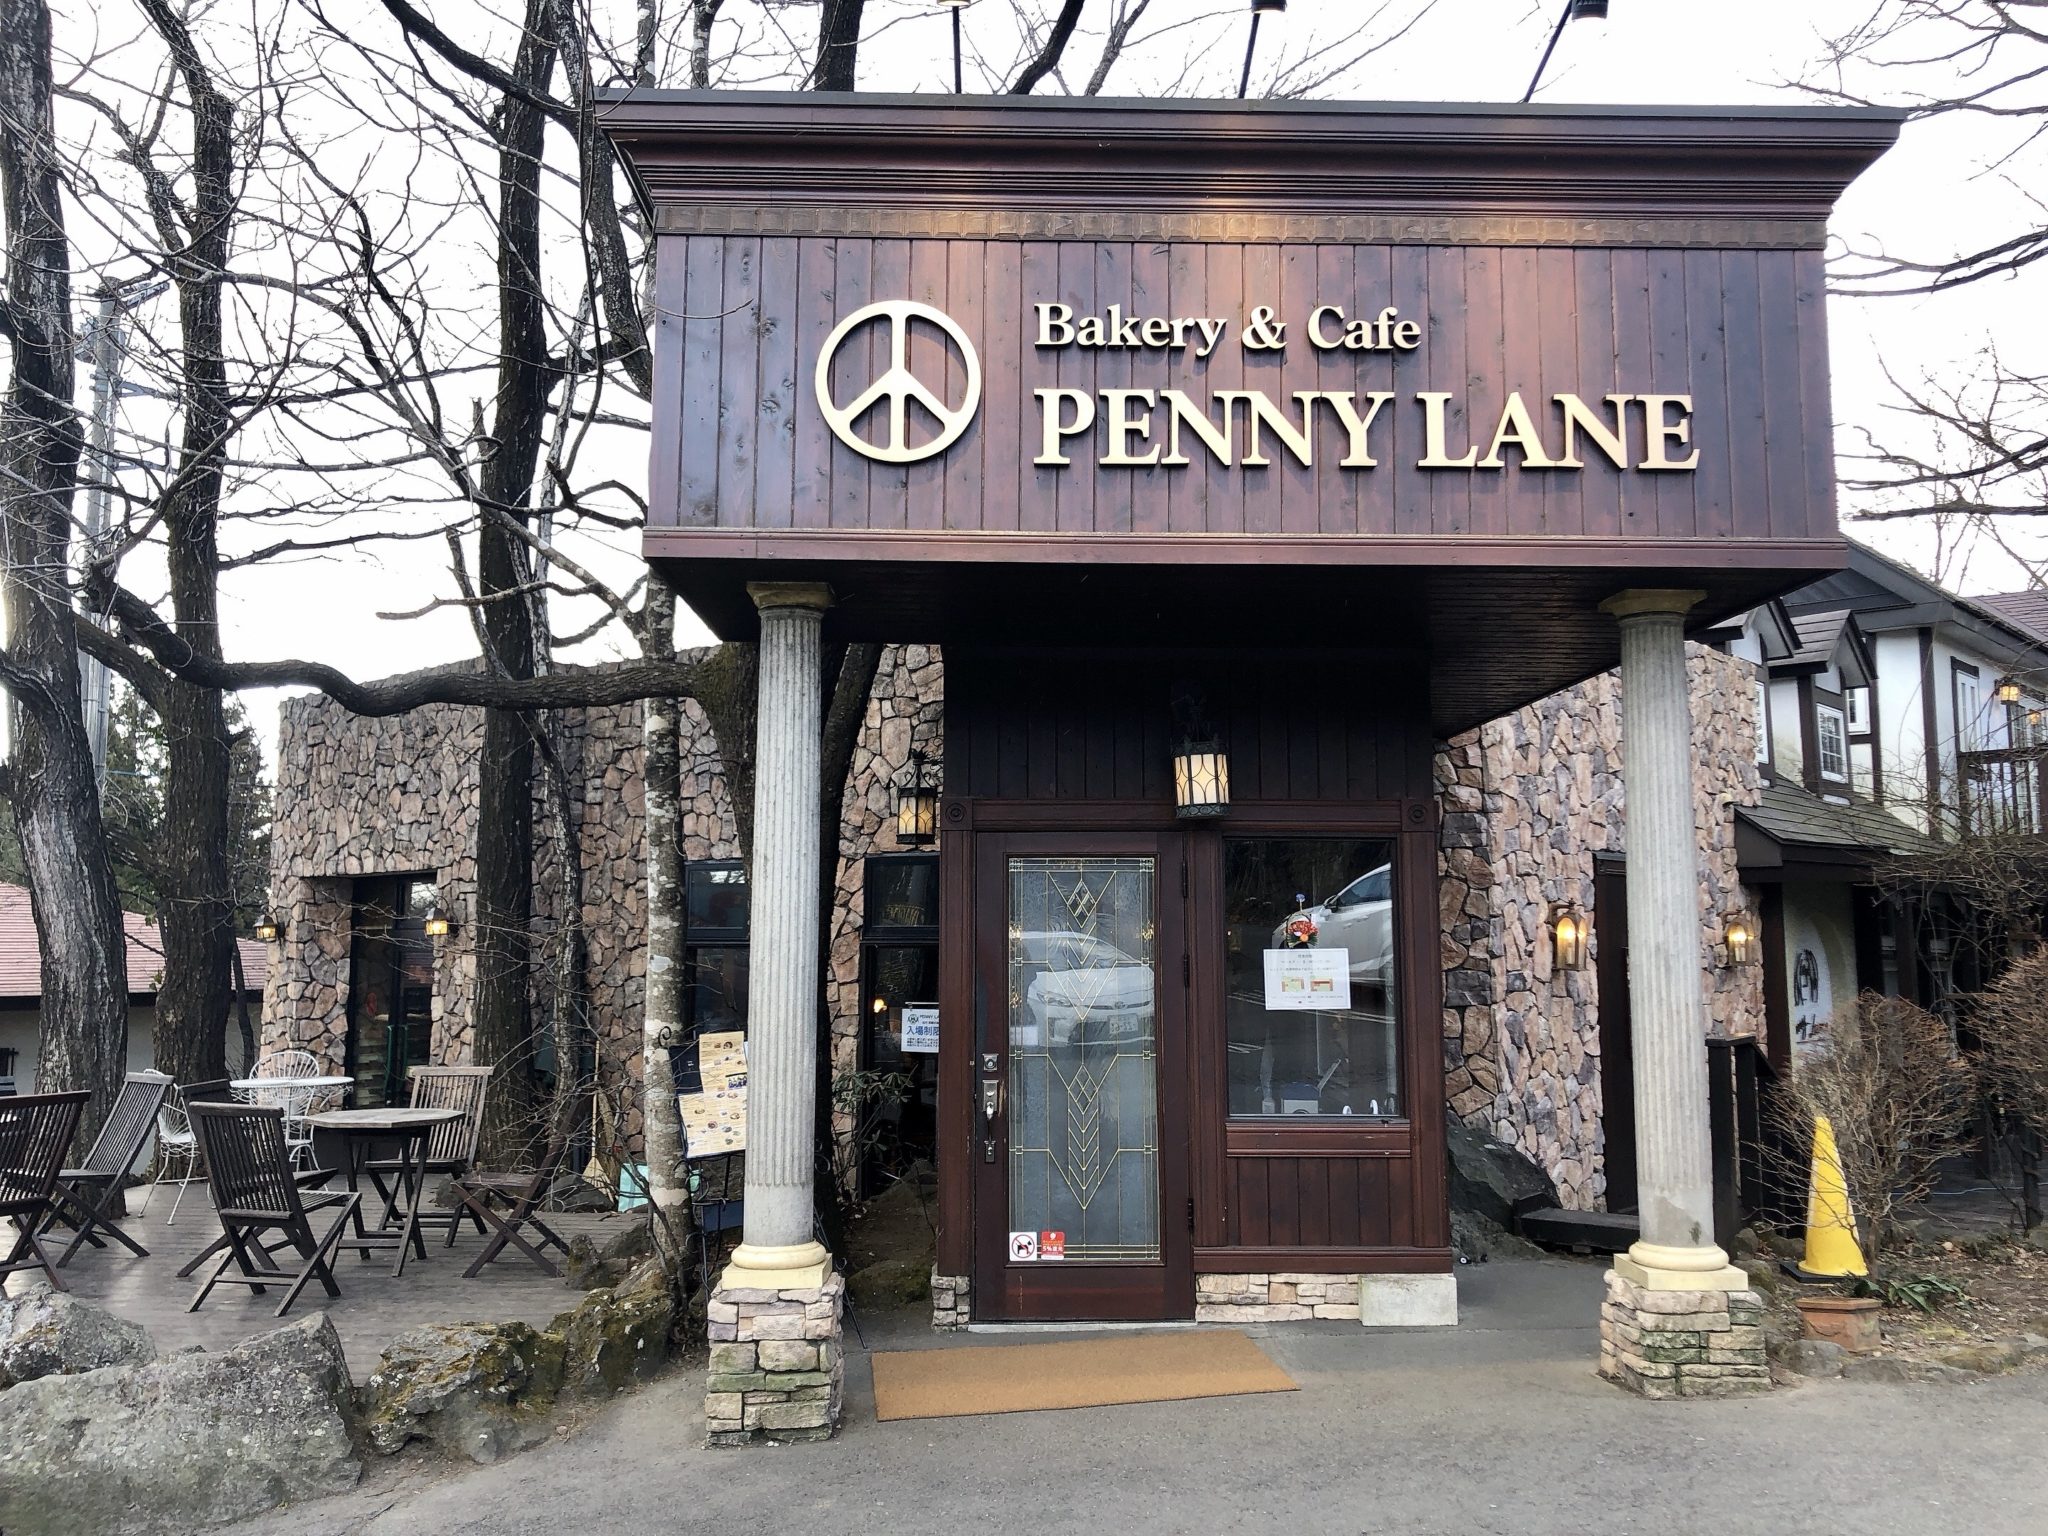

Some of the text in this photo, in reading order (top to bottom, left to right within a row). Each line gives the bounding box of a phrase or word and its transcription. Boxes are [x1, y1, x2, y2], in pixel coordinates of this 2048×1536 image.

[1034, 303, 1422, 357] Bakery & Cafe
[1033, 388, 1700, 471] PENNY LANE
